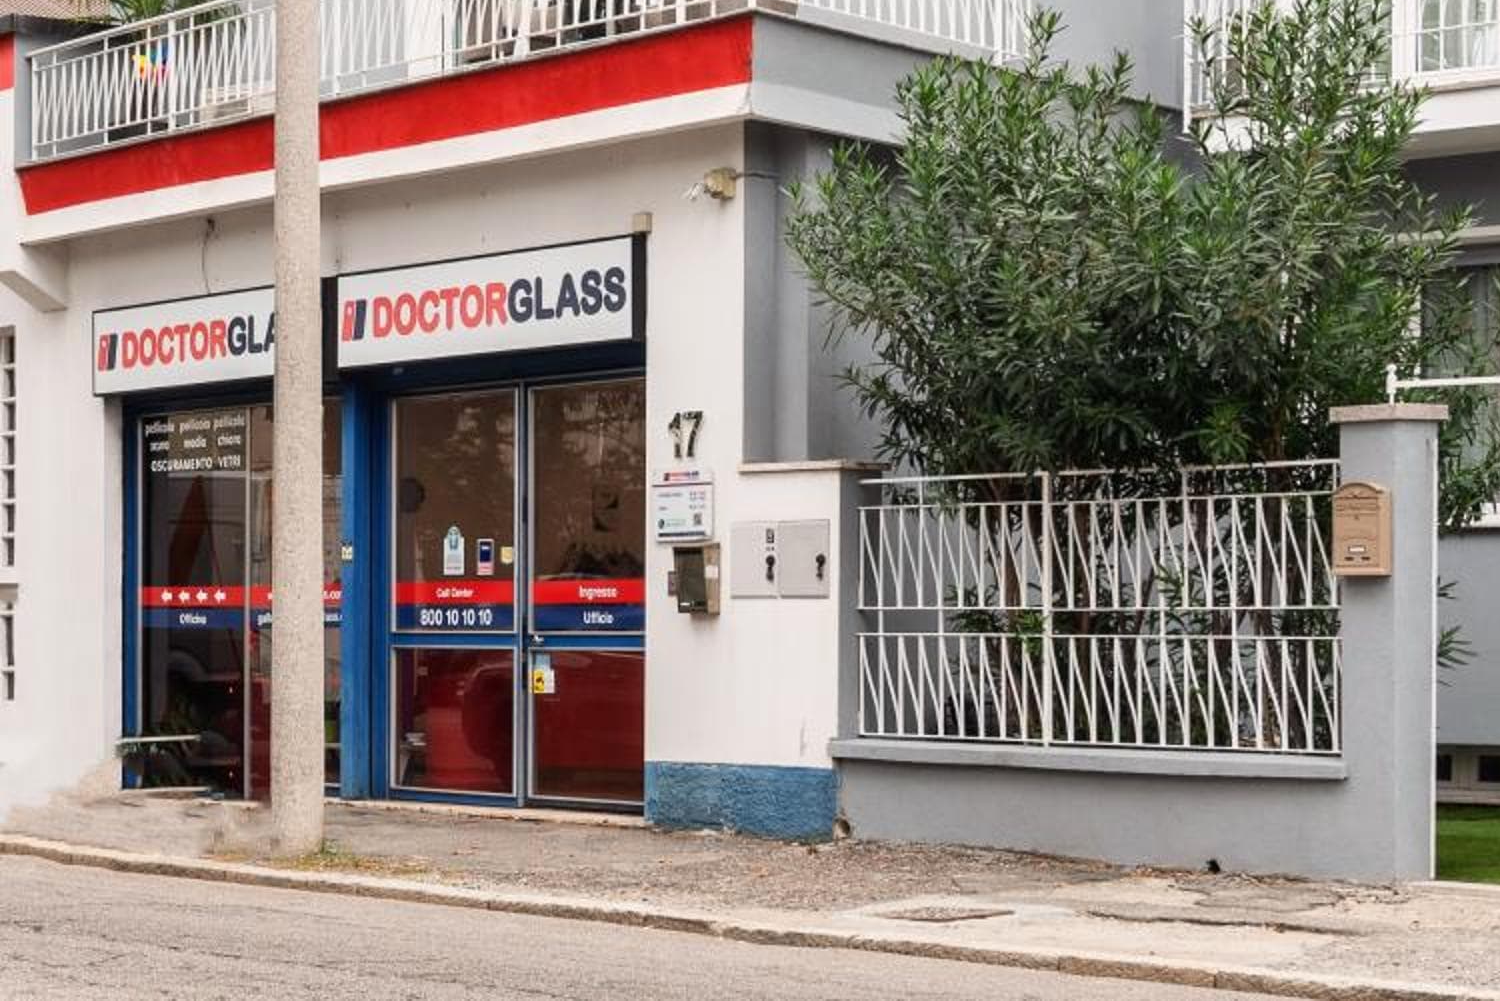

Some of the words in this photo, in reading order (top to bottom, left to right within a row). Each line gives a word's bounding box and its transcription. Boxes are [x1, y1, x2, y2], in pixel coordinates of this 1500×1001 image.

[372, 266, 627, 338] DOCTORGLASS
[121, 312, 275, 369] DOCTORGLA
[669, 410, 704, 459] 17
[151, 457, 213, 472] OSCURAMENTO
[217, 454, 241, 469] VETRI
[578, 585, 617, 601] Ingresso
[420, 608, 443, 626] 800
[445, 608, 459, 626] 10
[462, 608, 476, 626] 10
[478, 608, 493, 626] 10
[582, 611, 615, 625] Ufficio
